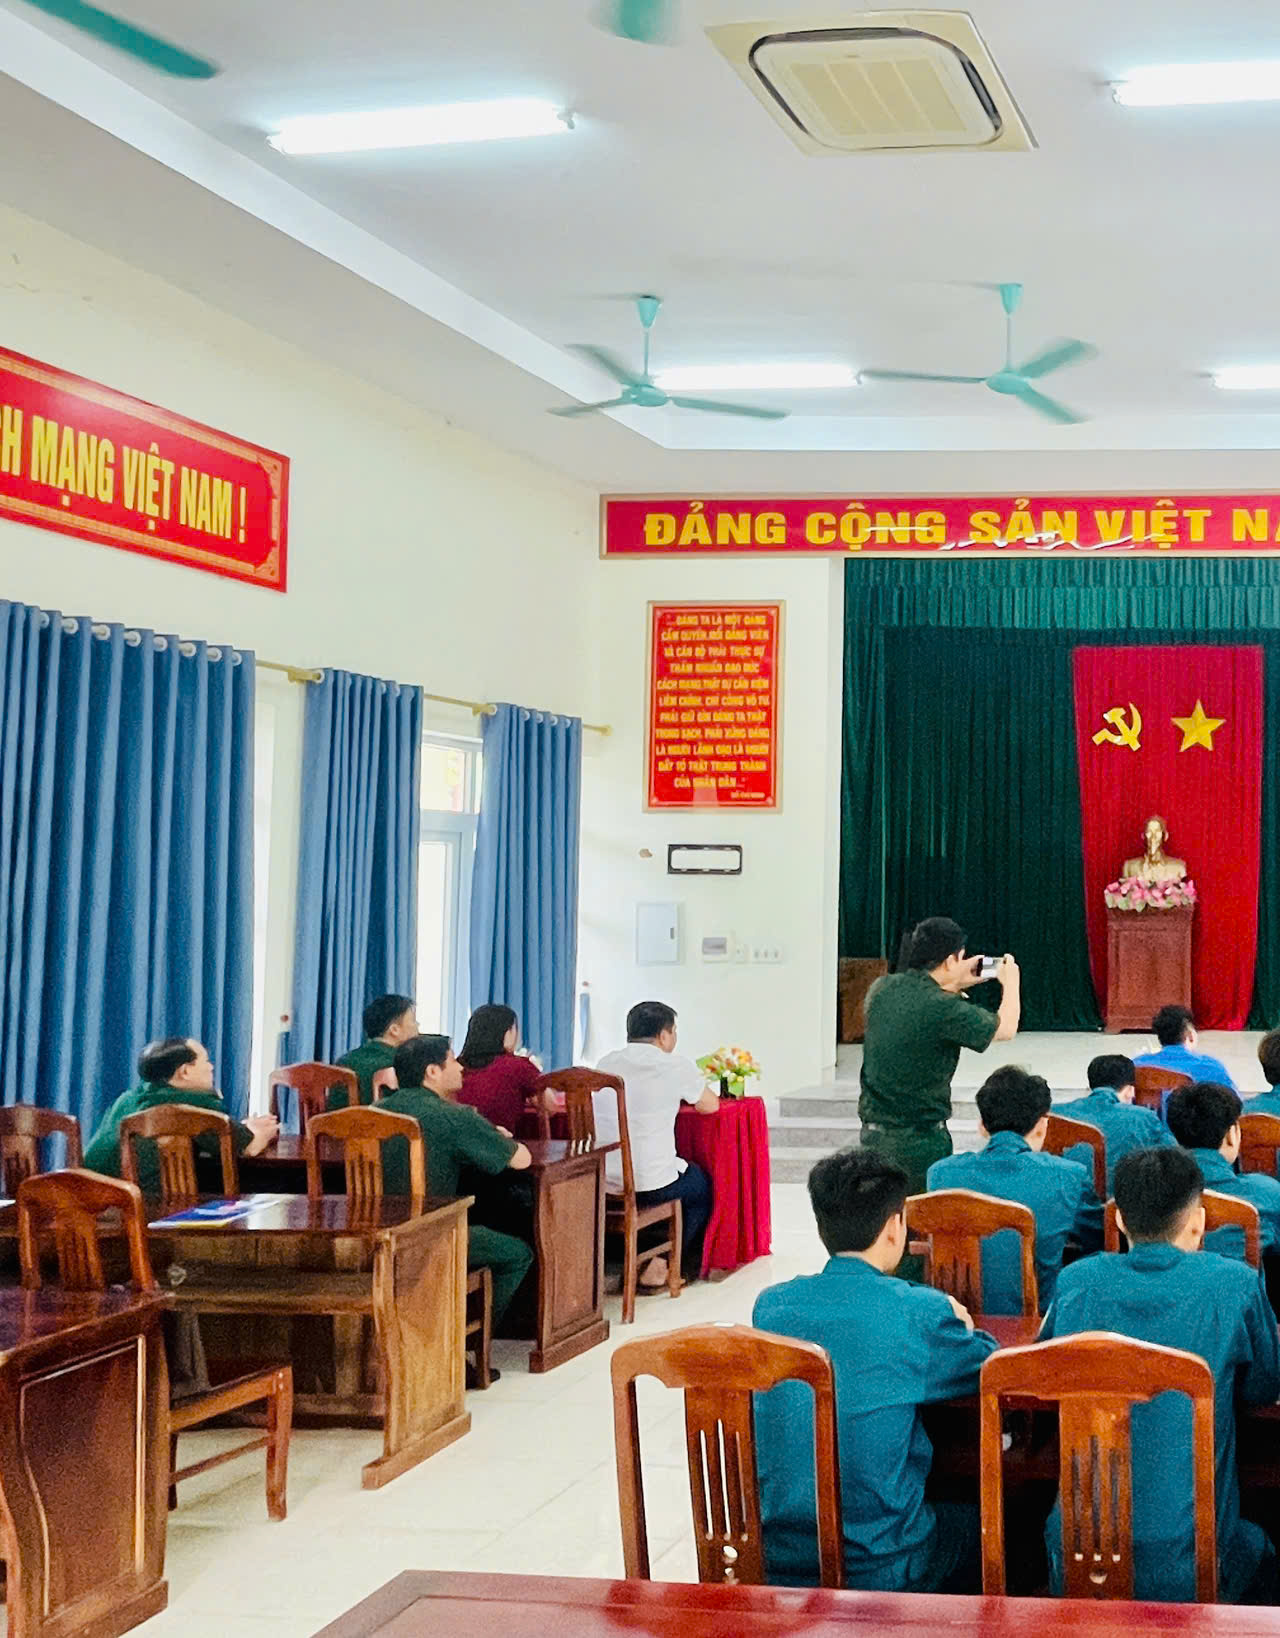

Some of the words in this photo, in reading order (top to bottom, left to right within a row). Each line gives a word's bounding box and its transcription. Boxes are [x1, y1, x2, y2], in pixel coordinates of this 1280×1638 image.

[0, 404, 22, 476] H
[31, 416, 115, 507] MẠNG
[122, 442, 174, 531] VIỆT
[180, 466, 232, 539] NAM
[644, 501, 785, 546] ĐẢNG
[805, 503, 947, 551] CỘNG
[969, 497, 1076, 548] SẢN
[1094, 499, 1211, 549] VIỆT
